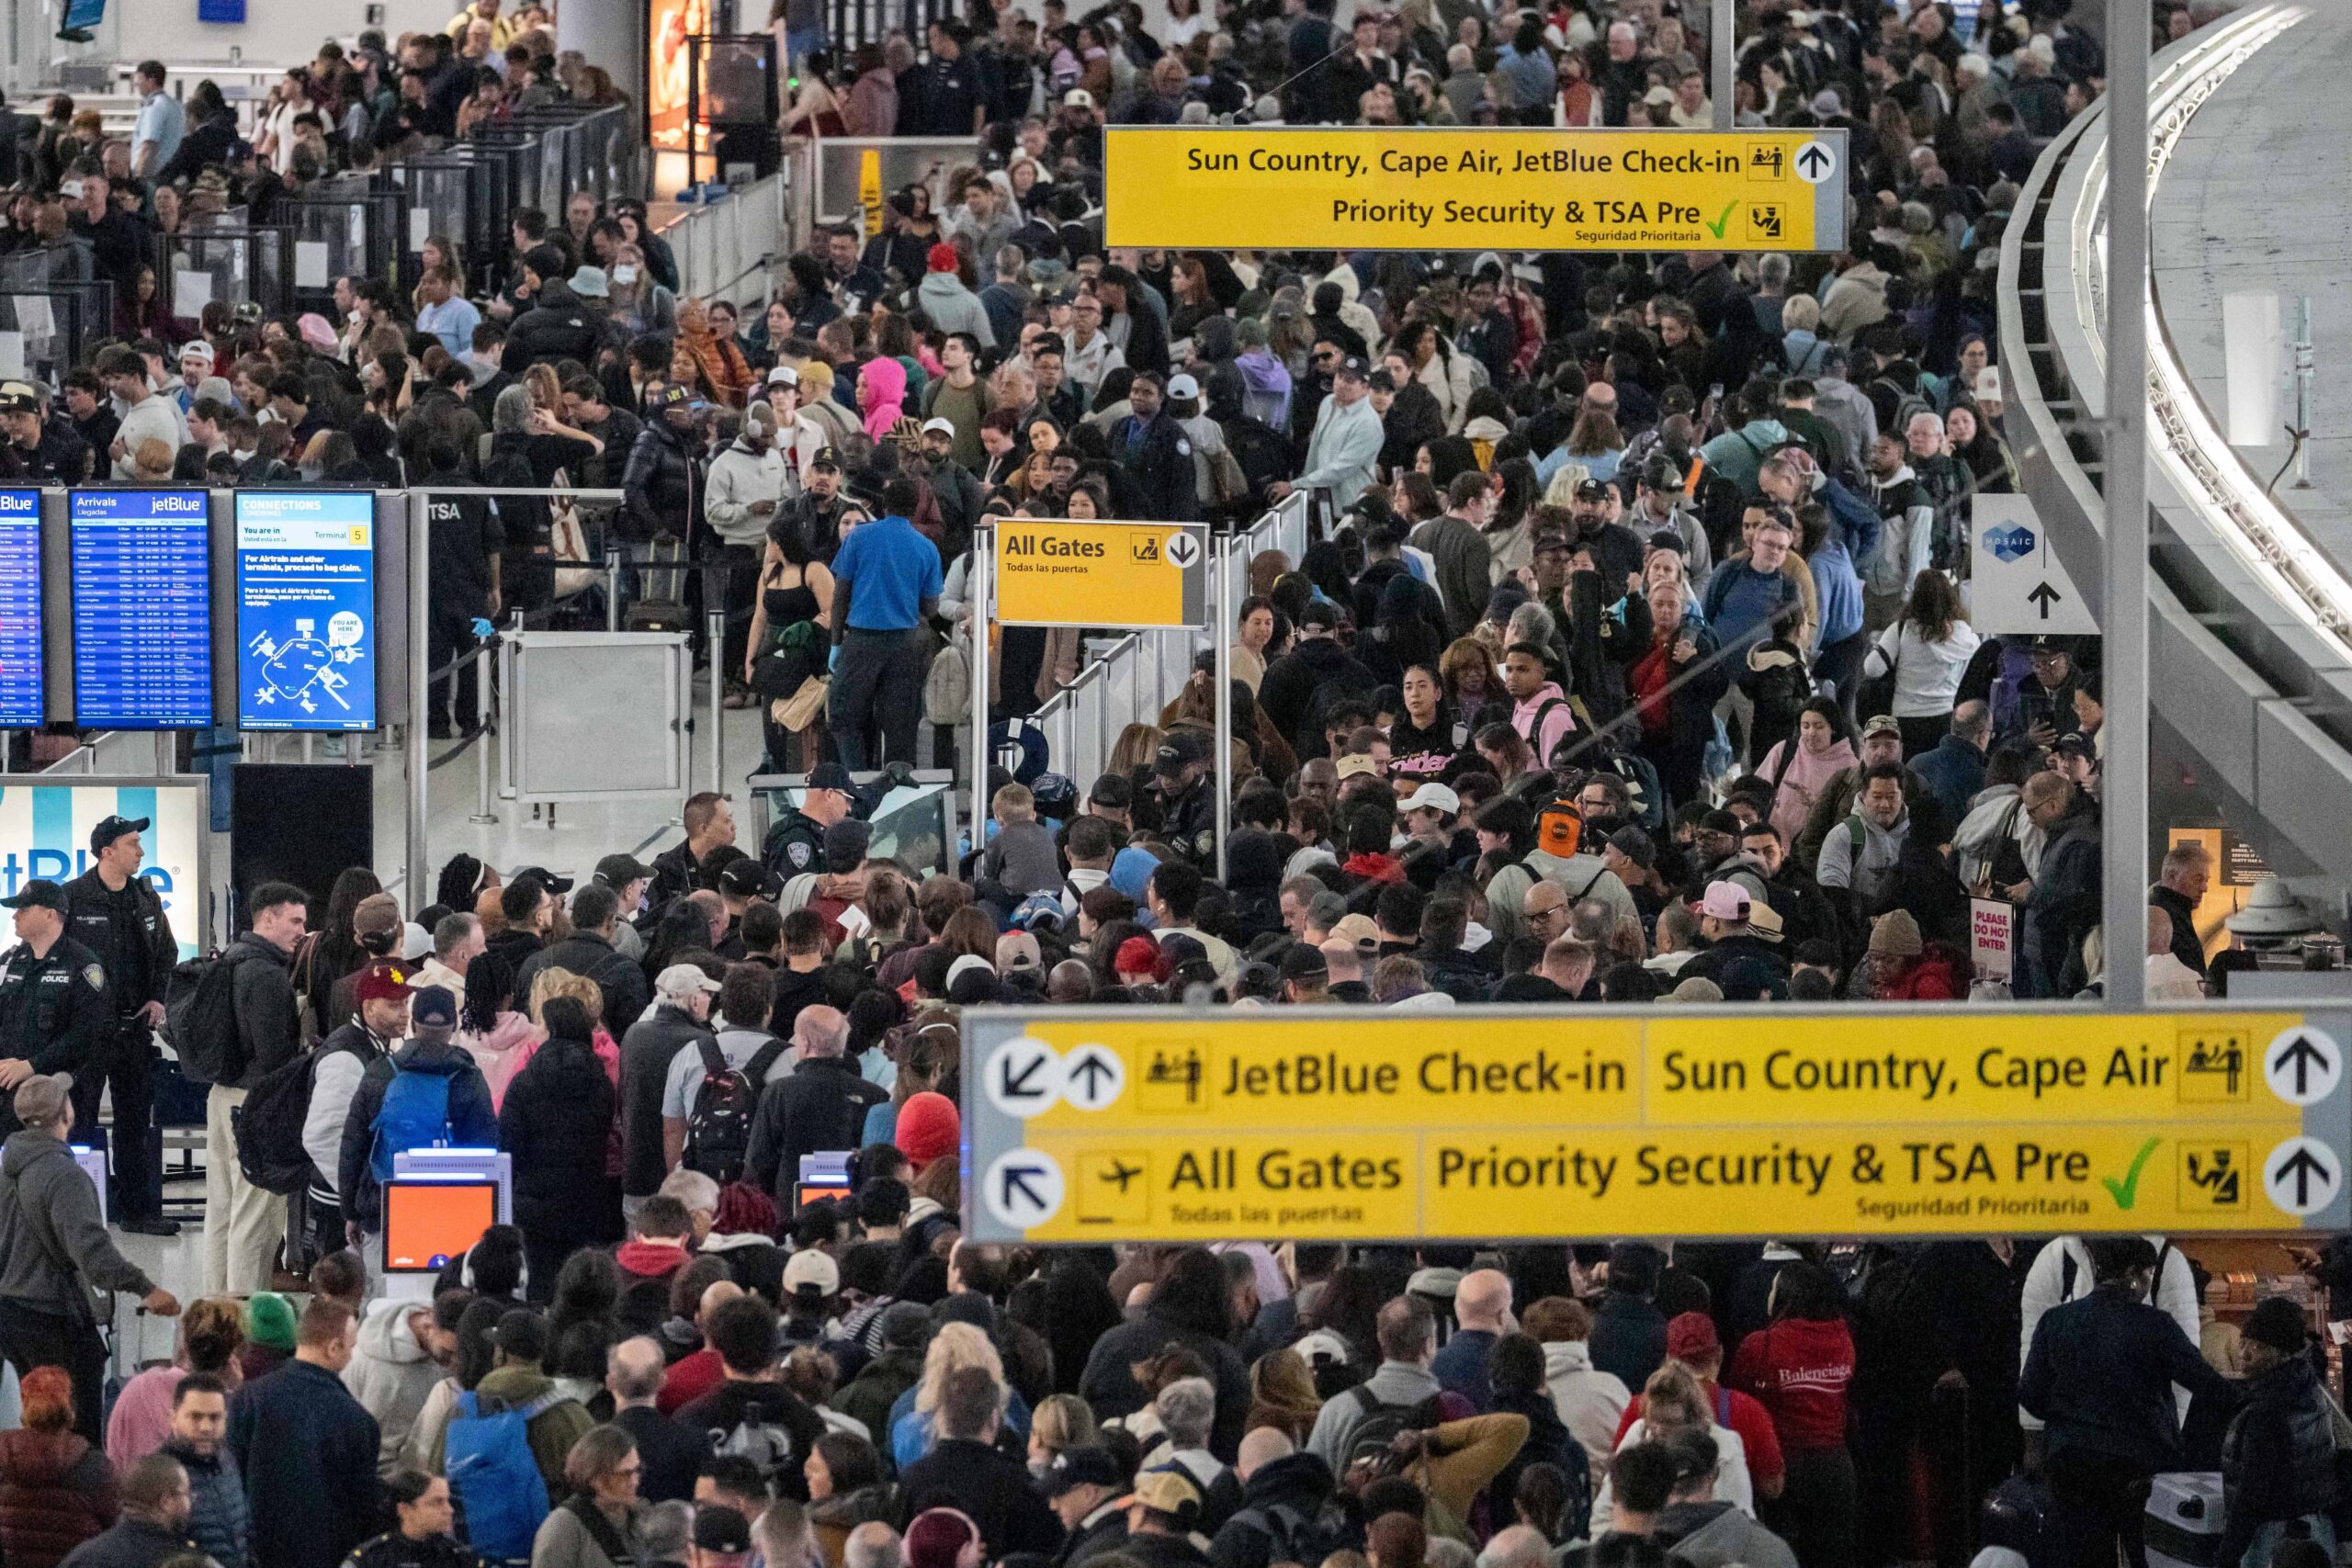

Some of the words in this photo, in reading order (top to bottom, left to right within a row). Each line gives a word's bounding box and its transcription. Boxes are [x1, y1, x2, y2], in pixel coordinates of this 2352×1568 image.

[1188, 148, 1238, 171] Sun
[1249, 148, 1368, 178] Country,
[1380, 150, 1448, 178] Cape
[1457, 149, 1503, 175] Air,
[1511, 149, 1612, 175] JetBlue
[1623, 149, 1740, 173] Check-in
[1333, 198, 1434, 229] Priority
[1444, 199, 1555, 230] Security
[1565, 200, 1585, 223] &
[1593, 201, 1648, 224] TSA
[1657, 201, 1701, 224] Pre
[1575, 230, 1637, 243] Seguridad
[1641, 230, 1701, 242] Prioritaria
[76, 497, 117, 507] Arrivals
[151, 497, 200, 514] jetBlue
[243, 500, 322, 511] CONNECTIONS
[77, 509, 107, 517] Llegadas
[428, 502, 461, 520] TSA
[355, 531, 361, 540] 5
[1985, 537, 2031, 546] MOSAIC
[1005, 535, 1035, 556] All
[1040, 536, 1105, 558] Gates
[245, 564, 283, 572] terminals,
[1006, 562, 1034, 572] Todas
[1035, 563, 1049, 572] las
[1051, 564, 1089, 575] puertas
[1975, 910, 2007, 926] PLEASE
[1974, 923, 1988, 935] DO
[1990, 926, 2009, 939] NOT
[1978, 937, 2006, 951] ENTER
[40, 975, 70, 983] POLICE
[1223, 1053, 1399, 1096] JetBlue
[1418, 1050, 1626, 1094] Check-in
[1665, 1050, 1746, 1091] Sun
[1764, 1049, 1958, 1100] Country,
[1975, 1047, 2087, 1099] Cape
[2103, 1044, 2170, 1087] Air
[1169, 1148, 1236, 1190] All
[1256, 1149, 1402, 1190] Gates
[1440, 1145, 1617, 1198] Priority
[1636, 1143, 1832, 1196] Security
[1850, 1143, 1884, 1184] &
[1902, 1143, 1996, 1183] TSA
[2015, 1143, 2090, 1183] Pre
[1170, 1203, 1232, 1223] Todas
[1239, 1204, 1272, 1223] las
[1278, 1205, 1364, 1226] puertas
[1856, 1196, 1972, 1223] Seguridad
[1977, 1195, 2091, 1217] Prioritaria
